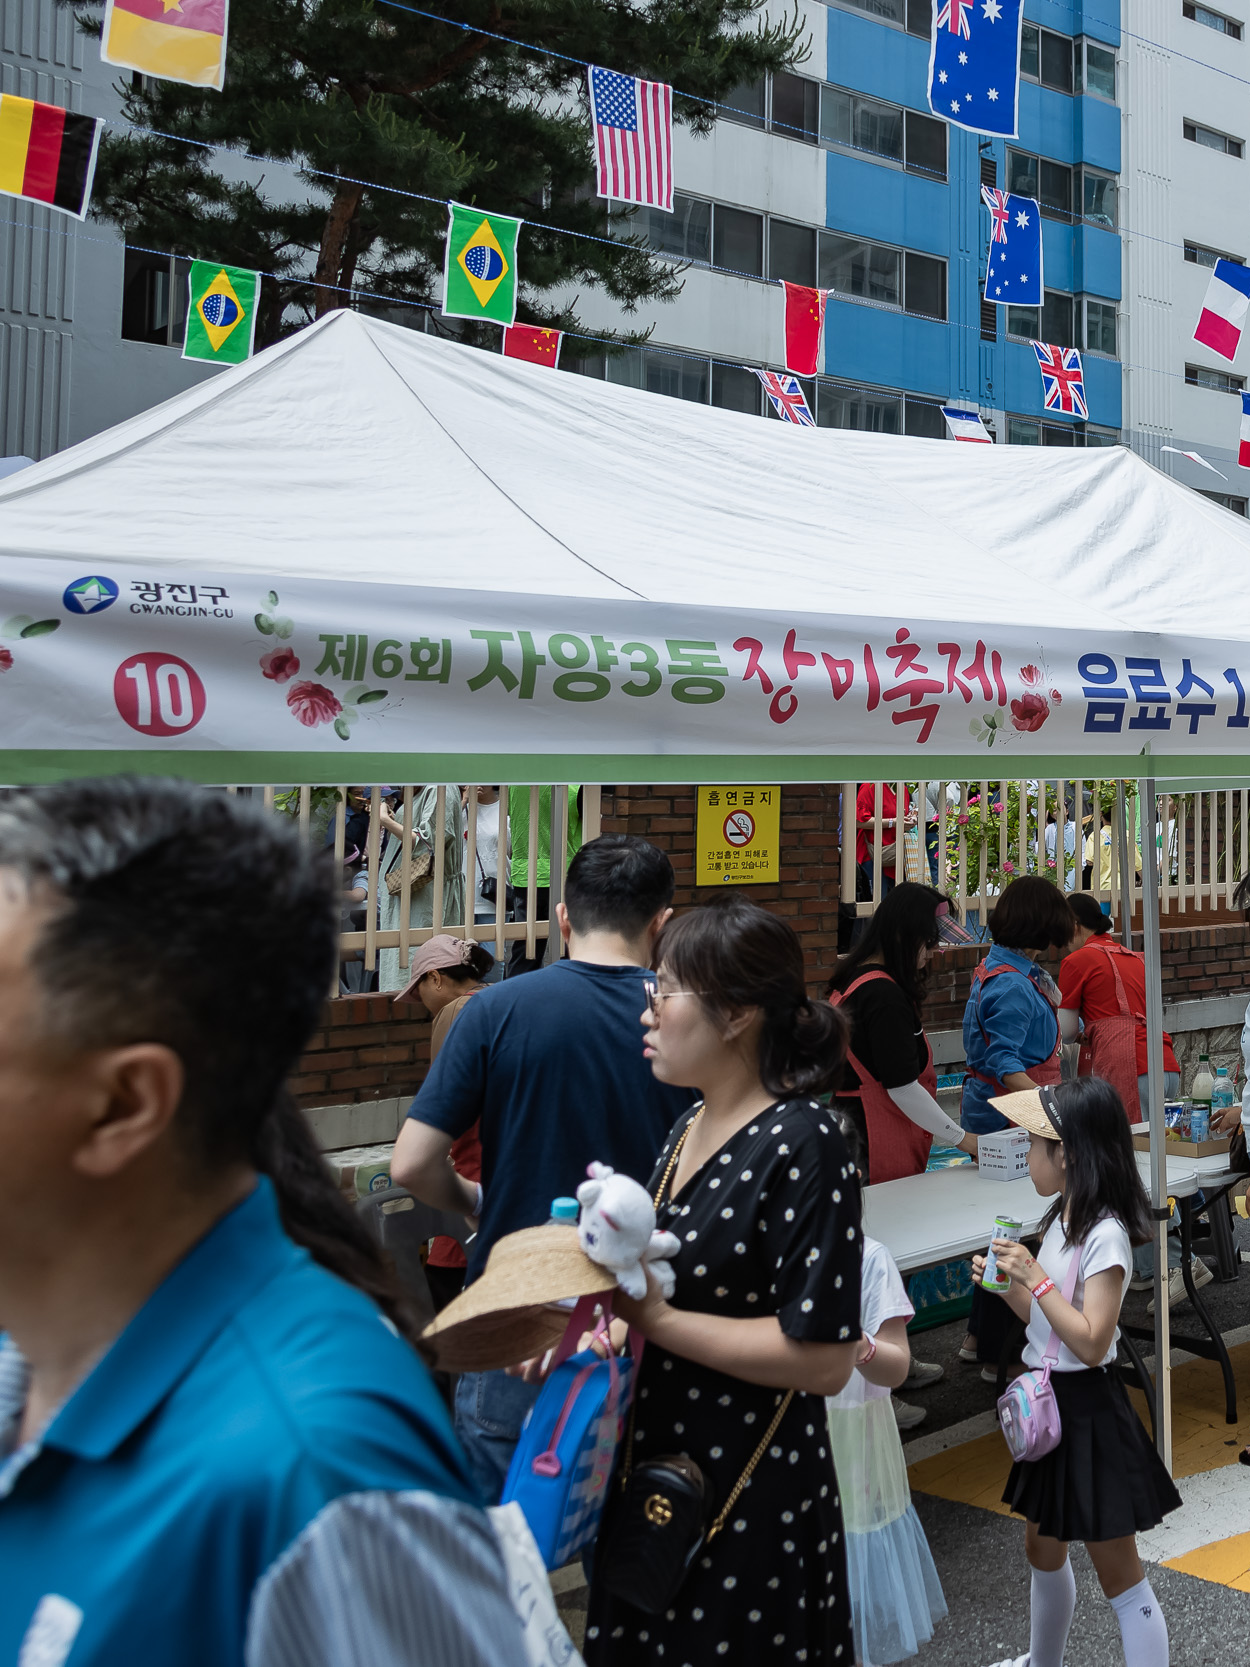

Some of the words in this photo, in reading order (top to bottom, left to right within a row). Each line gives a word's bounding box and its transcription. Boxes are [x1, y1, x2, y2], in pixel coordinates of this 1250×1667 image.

[130, 581, 230, 605] 광진구
[130, 603, 234, 618] GWANGJIN-GU
[314, 633, 452, 684] 제6회
[467, 629, 729, 705] 자양3동
[733, 627, 1008, 744] 장미축제
[1077, 653, 1217, 735] 음료수
[125, 662, 194, 727] 10
[708, 790, 772, 807] 흡연금지
[707, 850, 740, 860] 간접흡연
[744, 849, 769, 859] 피해로
[706, 862, 722, 871] 고통
[724, 862, 739, 870] 받고
[740, 860, 769, 870] 있습니다
